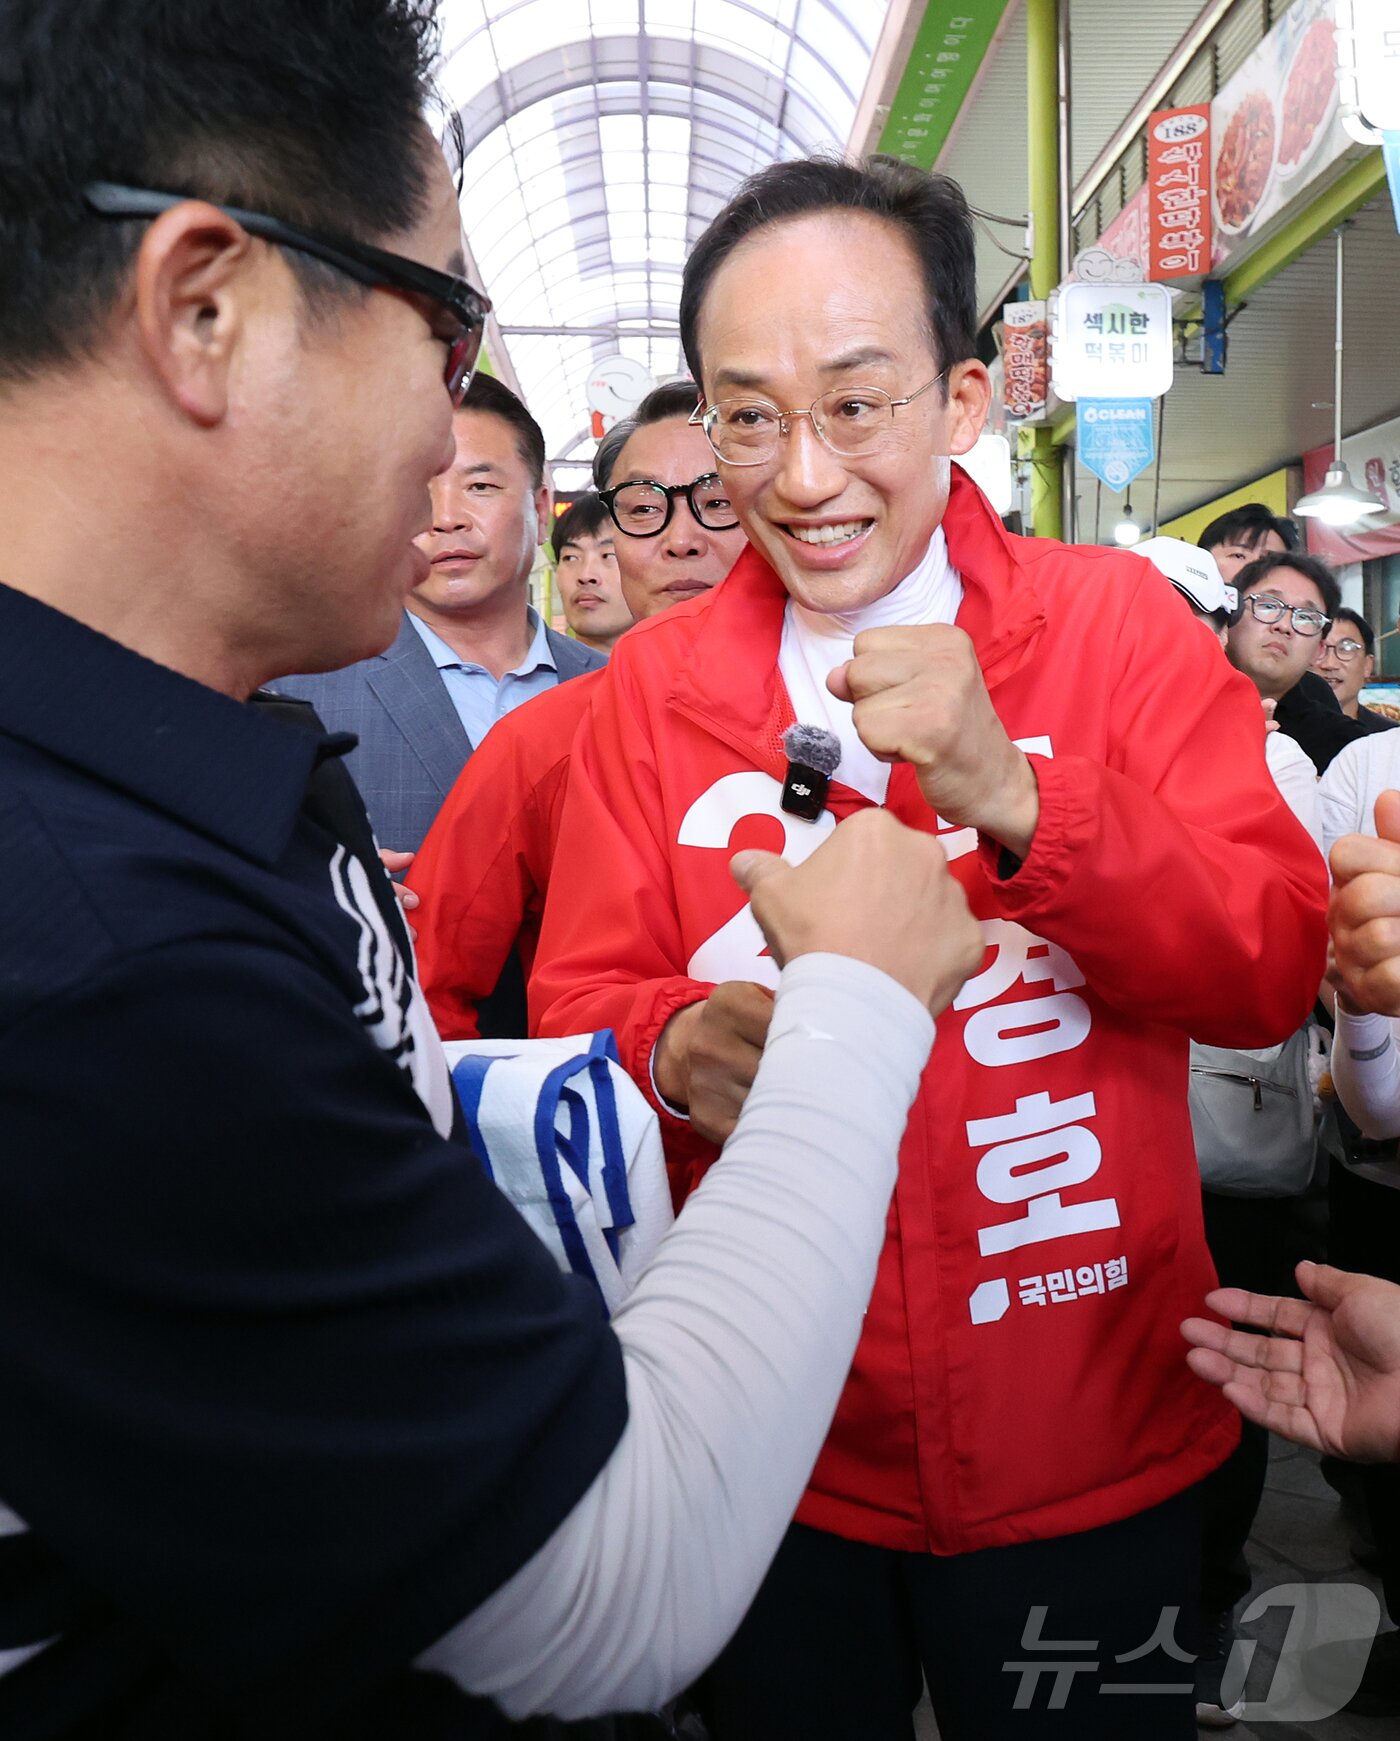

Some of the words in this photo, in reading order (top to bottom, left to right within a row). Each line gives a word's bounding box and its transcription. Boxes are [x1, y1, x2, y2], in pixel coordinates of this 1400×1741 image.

[1083, 312, 1150, 335] 섹시한
[1085, 343, 1148, 364] 떡볶이
[1098, 408, 1147, 420] CLEAN
[1018, 1256, 1128, 1306] 국민의힘
